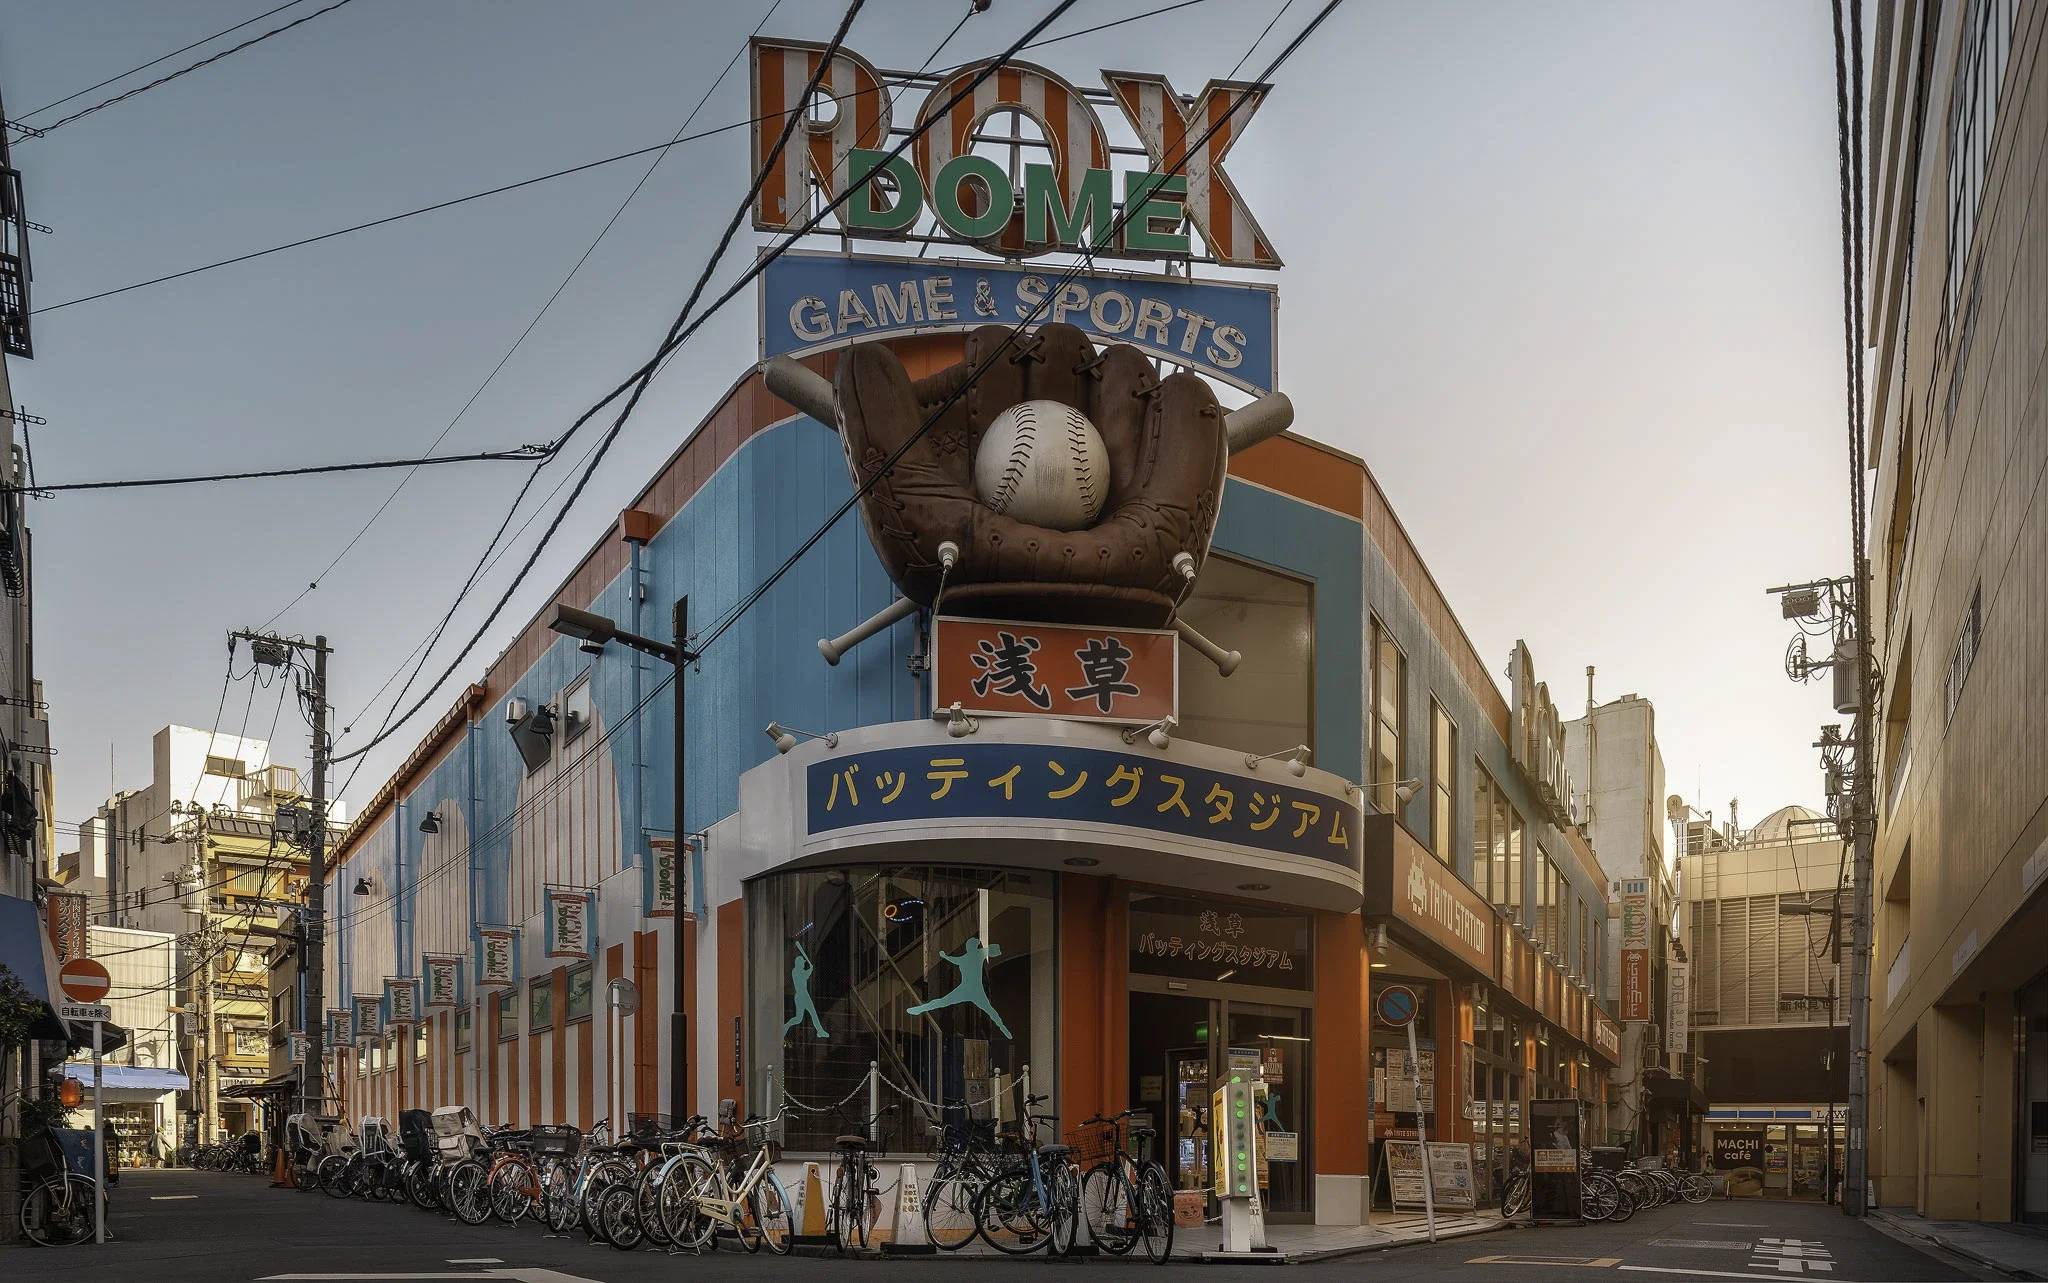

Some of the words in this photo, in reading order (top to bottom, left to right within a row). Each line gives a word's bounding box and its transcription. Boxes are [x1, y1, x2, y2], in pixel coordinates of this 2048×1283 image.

[749, 36, 1286, 270] ROX
[847, 149, 1190, 254] DOME
[789, 275, 958, 342] GAME
[973, 276, 998, 318] &
[1015, 275, 1247, 369] SPORTS
[969, 631, 1141, 714] 浅草
[826, 758, 1350, 851] バッティングスタジアム
[659, 857, 671, 901] DOME
[557, 907, 568, 944] DOME
[1200, 910, 1245, 939] 浅草
[1428, 877, 1453, 932] TAITO
[1455, 899, 1485, 956] STATION
[1624, 895, 1646, 947] ROX
[1139, 932, 1293, 970] バッティングスタジアム
[61, 1006, 110, 1019] 自転車を除く
[1631, 963, 1643, 1017] GAME
[1717, 1139, 1759, 1149] MACHI
[1724, 1149, 1752, 1160] café
